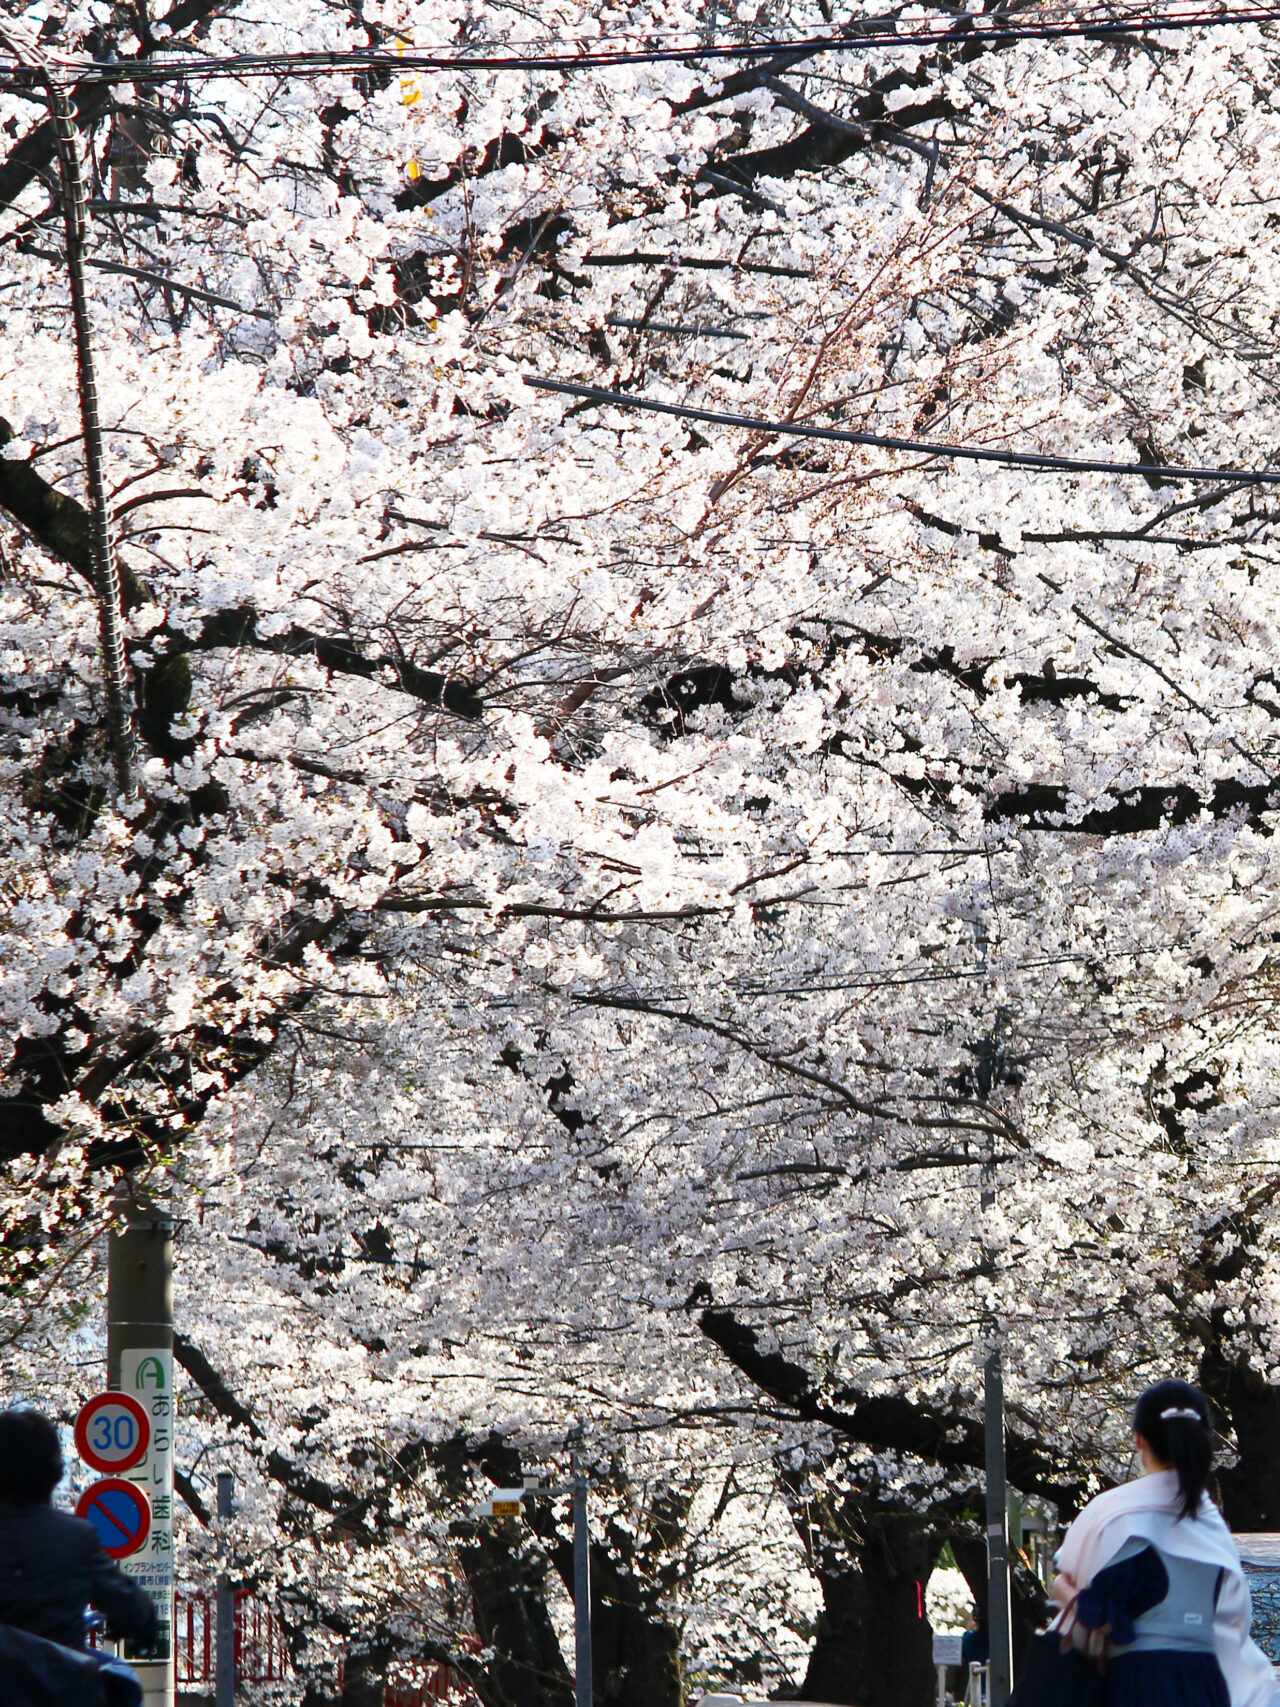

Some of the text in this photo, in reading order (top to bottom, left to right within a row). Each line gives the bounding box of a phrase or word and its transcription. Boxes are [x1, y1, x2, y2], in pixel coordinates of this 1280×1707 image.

[93, 1415, 134, 1451] 30
[152, 1393, 171, 1556] あらい歯科
